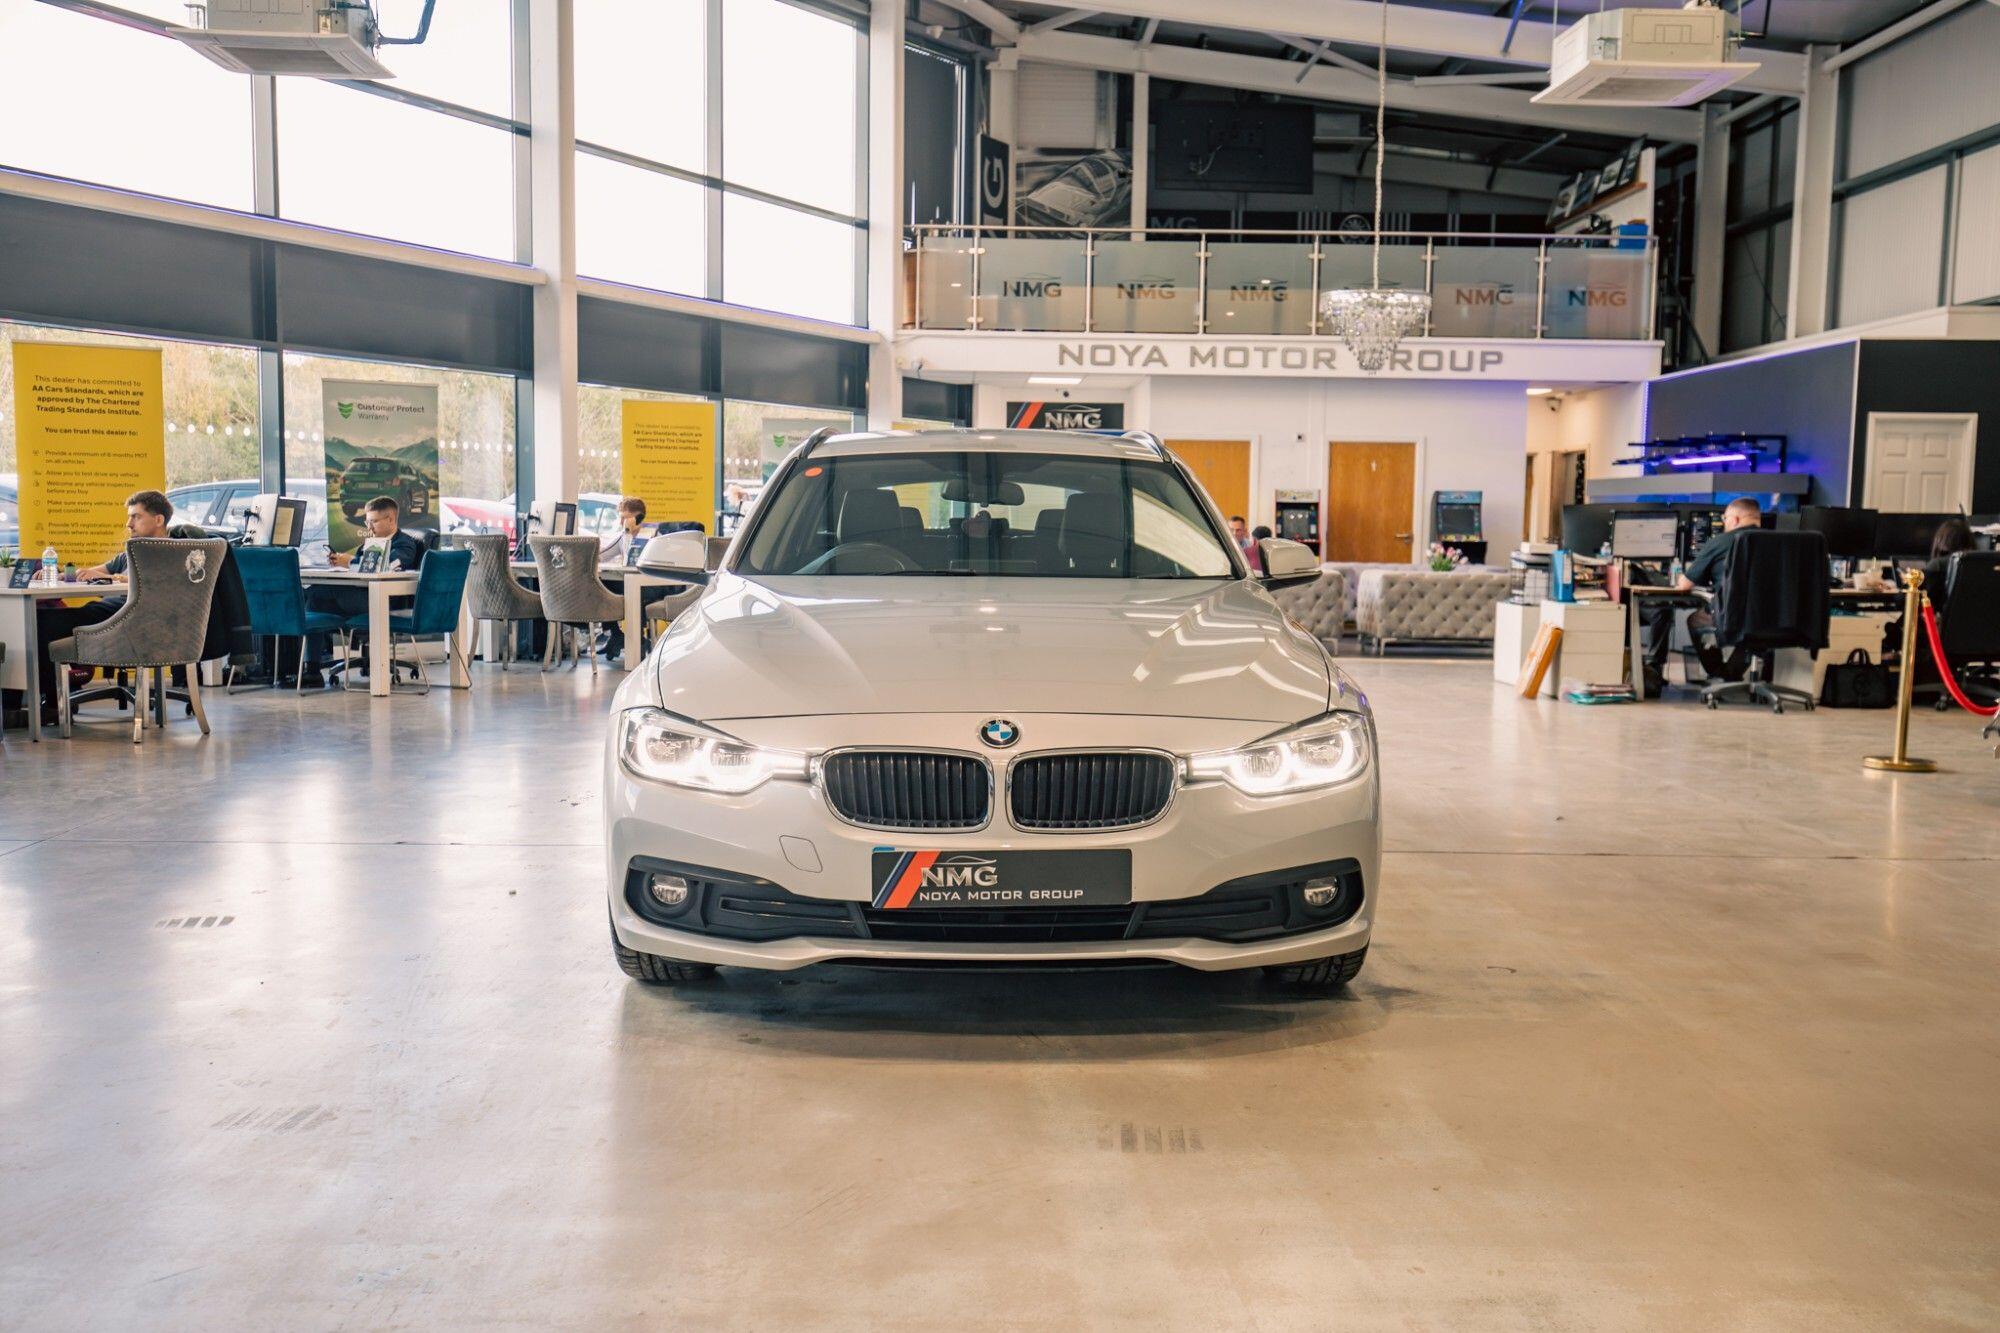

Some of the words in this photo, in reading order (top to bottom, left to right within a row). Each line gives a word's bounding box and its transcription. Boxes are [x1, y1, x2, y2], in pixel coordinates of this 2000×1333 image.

[1003, 280, 1062, 299] NMG
[1117, 282, 1176, 300] NMG
[1229, 284, 1288, 302] NMG
[1456, 288, 1514, 305] NMG
[1568, 289, 1627, 307] NMG
[1058, 344, 1168, 367] NOYA
[1189, 345, 1337, 370] MOTOR
[78, 377, 91, 385] has
[92, 378, 132, 387] committed
[45, 385, 63, 393] Cars
[108, 388, 131, 396] which
[37, 396, 74, 405] approved
[75, 397, 85, 405] by
[86, 397, 101, 405] The
[102, 398, 140, 406] Chartered
[357, 402, 395, 412] Customer
[396, 405, 425, 414] Protect
[36, 405, 65, 414] Trading
[67, 406, 107, 415] Standards
[357, 412, 389, 421] Warranty
[1045, 411, 1101, 430] NMG
[45, 426, 58, 434] You
[91, 428, 105, 436] this
[920, 865, 998, 888] NMG
[919, 890, 961, 901] NOYA
[967, 890, 1022, 900] MOTOR
[1029, 889, 1084, 899] GROUP
